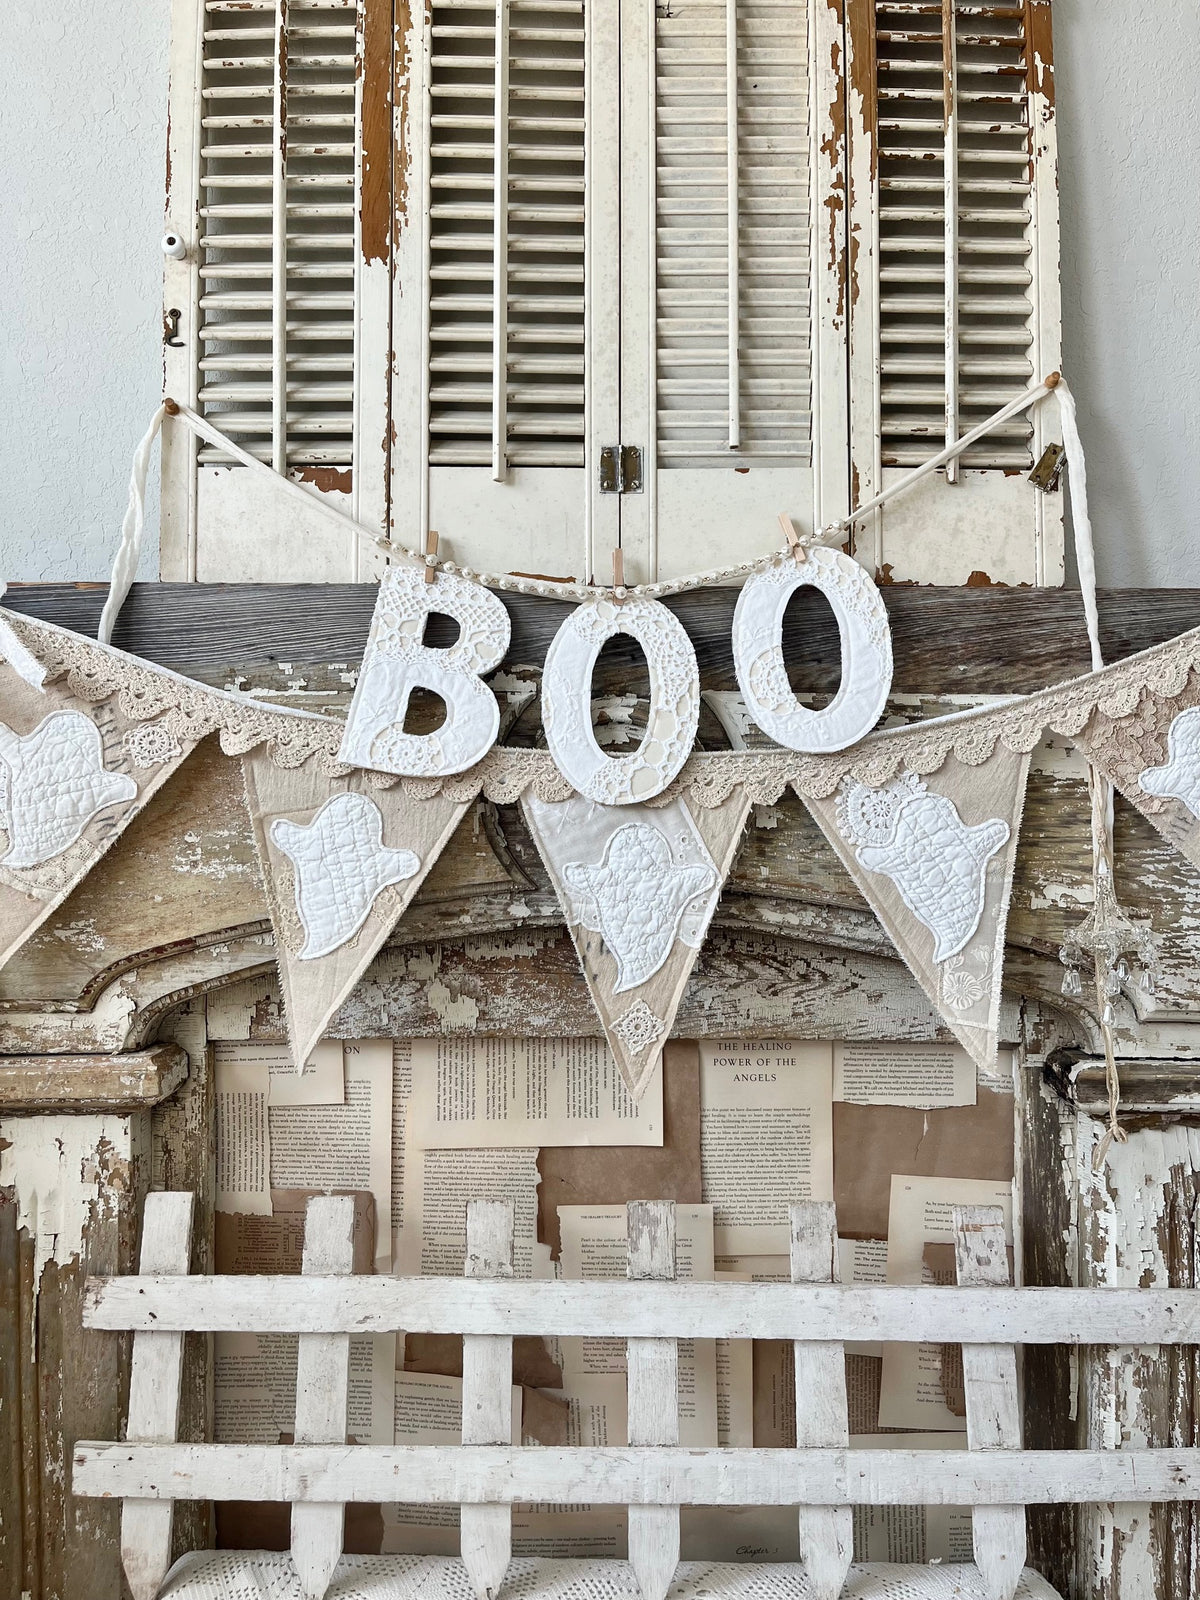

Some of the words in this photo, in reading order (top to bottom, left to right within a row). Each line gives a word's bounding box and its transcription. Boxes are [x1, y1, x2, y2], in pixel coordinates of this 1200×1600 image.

[338, 544, 893, 805] BOO
[717, 1042, 738, 1051] THE
[743, 1042, 792, 1051] HEALING
[713, 1058, 752, 1066] POWER
[756, 1058, 771, 1066] OF
[776, 1058, 797, 1066] THE
[733, 1073, 777, 1082] ANGELS
[736, 1545, 768, 1558] Chapter
